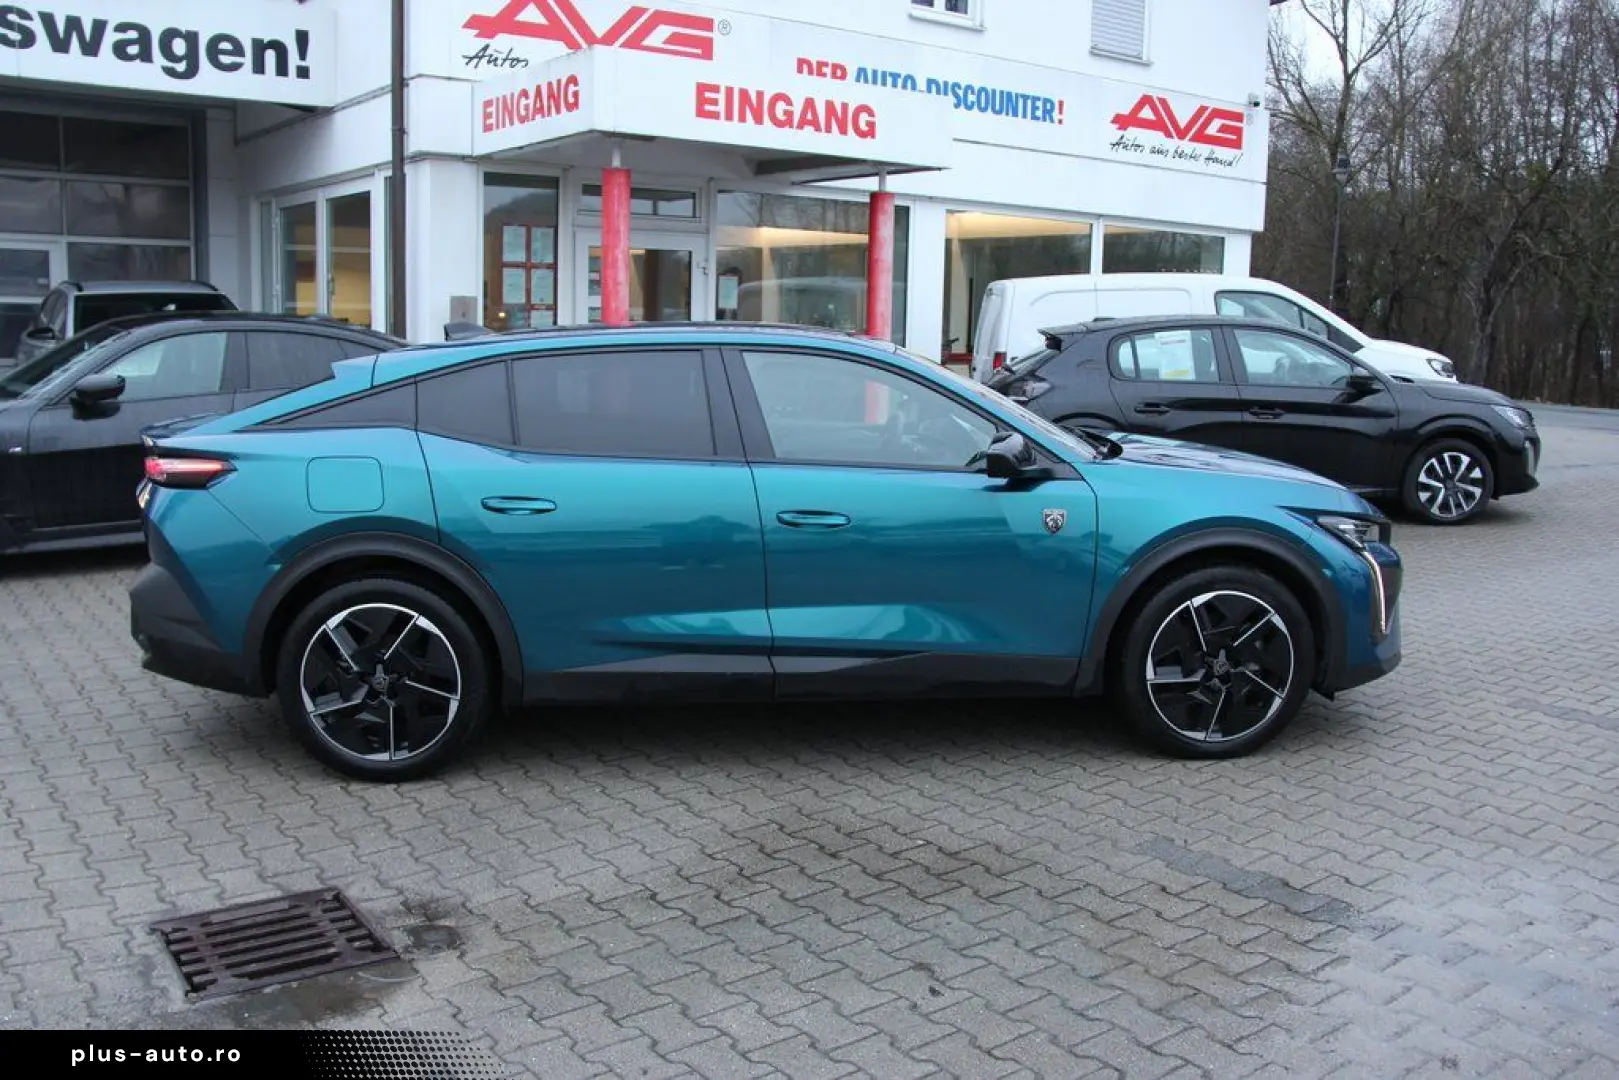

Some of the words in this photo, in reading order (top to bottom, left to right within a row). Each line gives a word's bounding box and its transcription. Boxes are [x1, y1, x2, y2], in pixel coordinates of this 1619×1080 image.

[0, 5, 311, 80] swagen!
[461, 0, 714, 61] AVG
[482, 74, 580, 134] EINGANG
[695, 82, 877, 140] EINGANG
[1110, 94, 1244, 150] AVG
